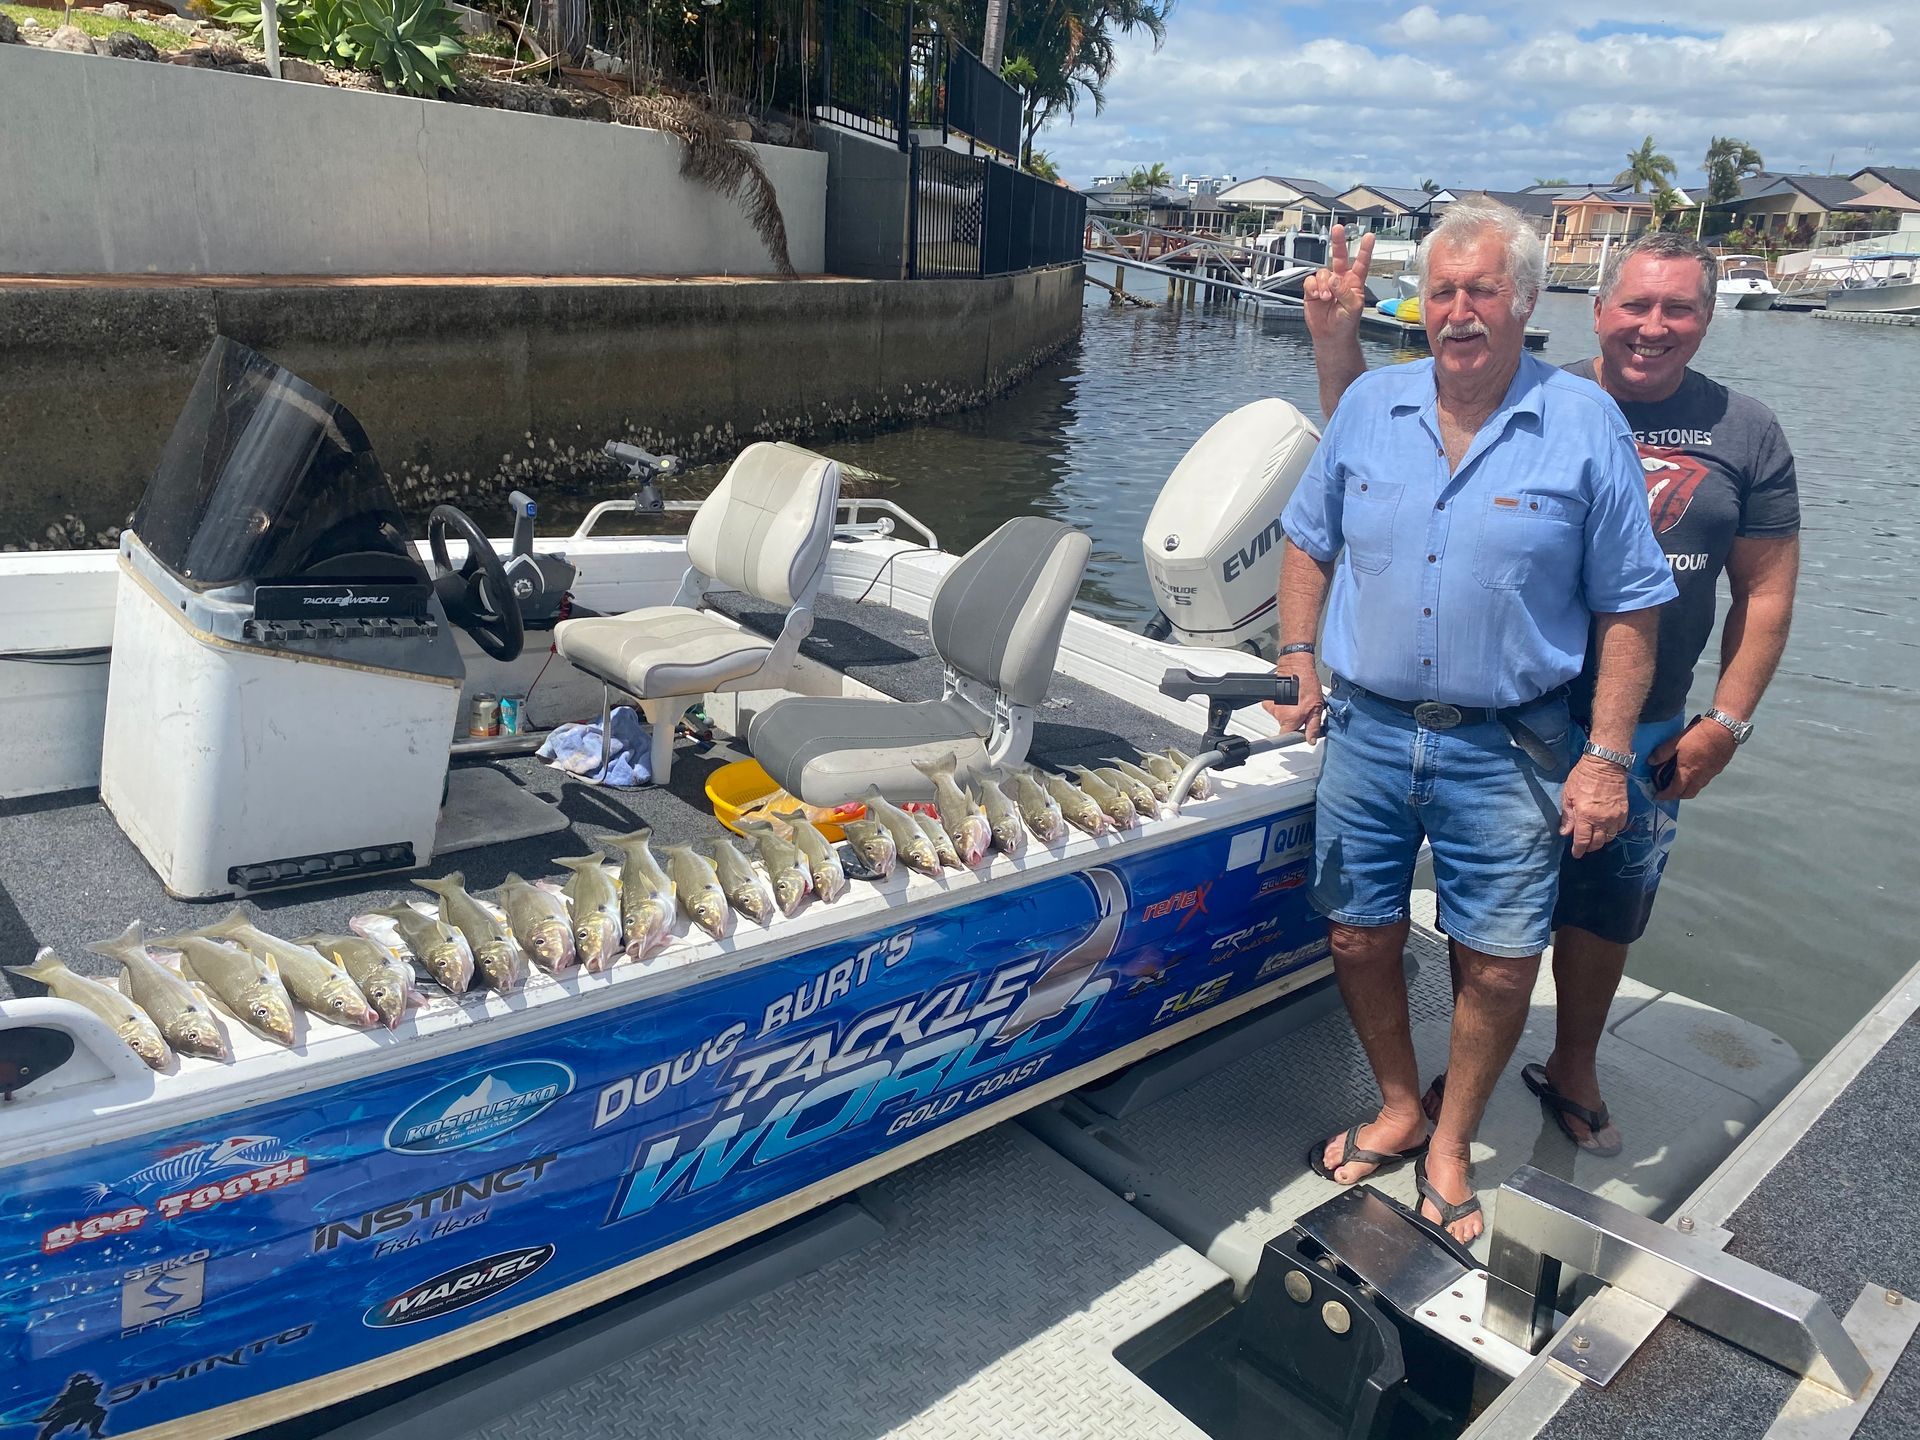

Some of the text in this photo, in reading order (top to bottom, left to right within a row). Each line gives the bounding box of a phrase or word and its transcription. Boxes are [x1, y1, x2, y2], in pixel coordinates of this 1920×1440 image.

[1648, 429, 1712, 446] STONES
[1666, 553, 1709, 571] TOUR
[303, 596, 389, 605] TACKLE WORLD
[1154, 971, 1235, 1021] FUZE
[593, 926, 918, 1129] DOUG BURT'S
[725, 957, 1041, 1111] TACKLE
[403, 1084, 559, 1145] KOSCIUSZKO
[618, 977, 1113, 1222] WORLD
[886, 1054, 1052, 1137] GOLD COAST
[313, 1153, 558, 1253] INSTINCT
[374, 1208, 489, 1259] Fish Hard
[123, 1248, 210, 1280] SEIKO
[394, 1274, 519, 1323] OUTDOOR PERFORMANCE
